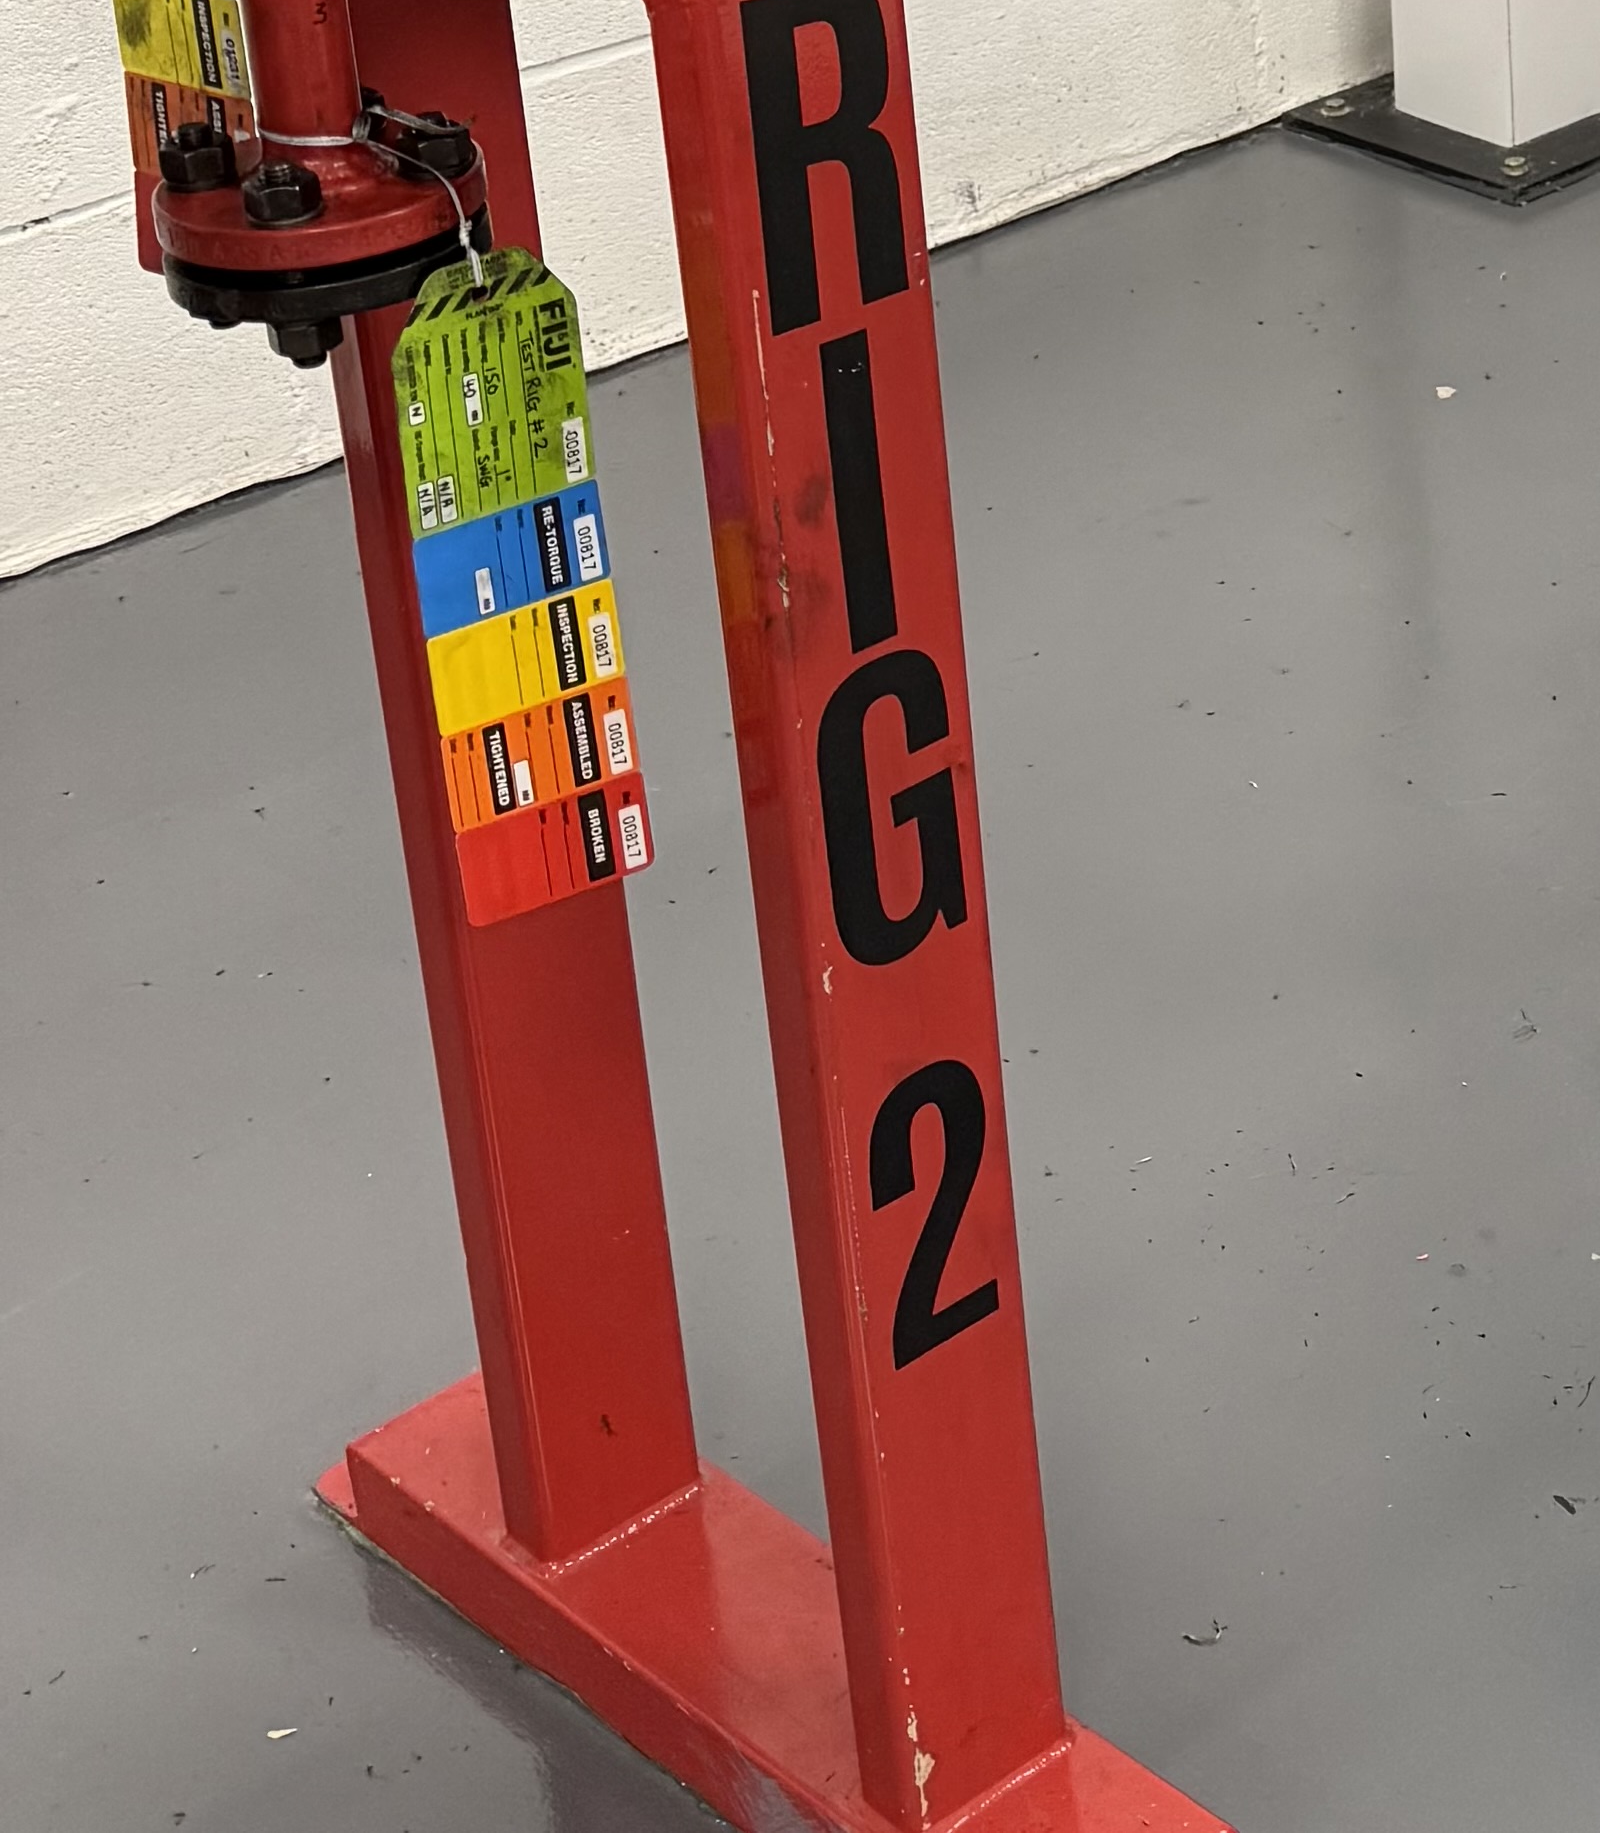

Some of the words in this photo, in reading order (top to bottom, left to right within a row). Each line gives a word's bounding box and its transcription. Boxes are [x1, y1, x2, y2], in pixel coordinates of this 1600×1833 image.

[197, 1, 217, 83] INSPECTION
[519, 333, 537, 373] TEST
[524, 375, 542, 413] RIG
[565, 431, 582, 474] 00817
[541, 506, 563, 584] RE-TORQUE
[577, 526, 597, 570] 00817
[557, 603, 578, 684] INSPECTION
[592, 624, 612, 668] 00817
[571, 701, 593, 780] ASSEMBLED
[607, 722, 628, 766] 00817
[489, 730, 509, 806] TIGHTENED
[587, 809, 606, 863] BROKEN
[622, 815, 642, 858] 00817
[869, 1059, 999, 1371] 2
